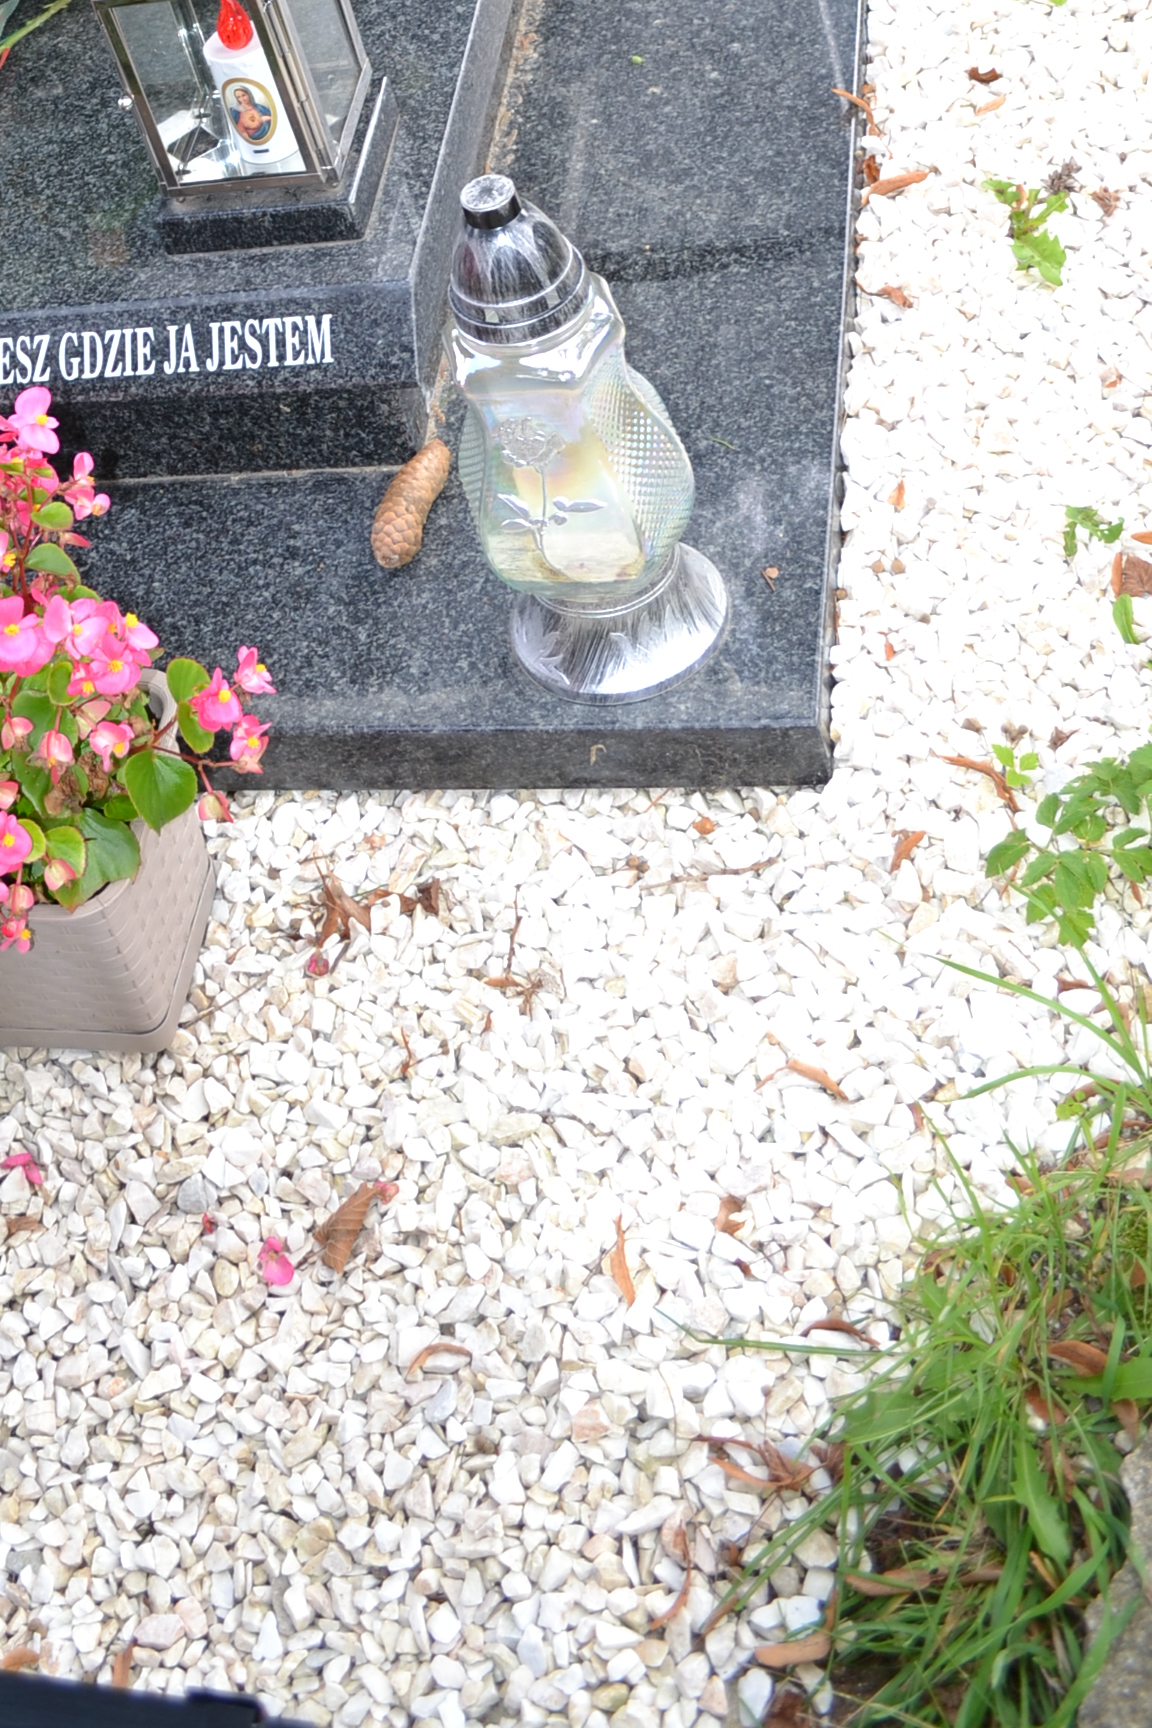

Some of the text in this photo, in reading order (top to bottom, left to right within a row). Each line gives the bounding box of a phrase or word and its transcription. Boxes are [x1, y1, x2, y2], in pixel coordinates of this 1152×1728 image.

[58, 326, 156, 381] GDZIE
[163, 323, 198, 376] JA
[205, 313, 335, 372] JESTEM
